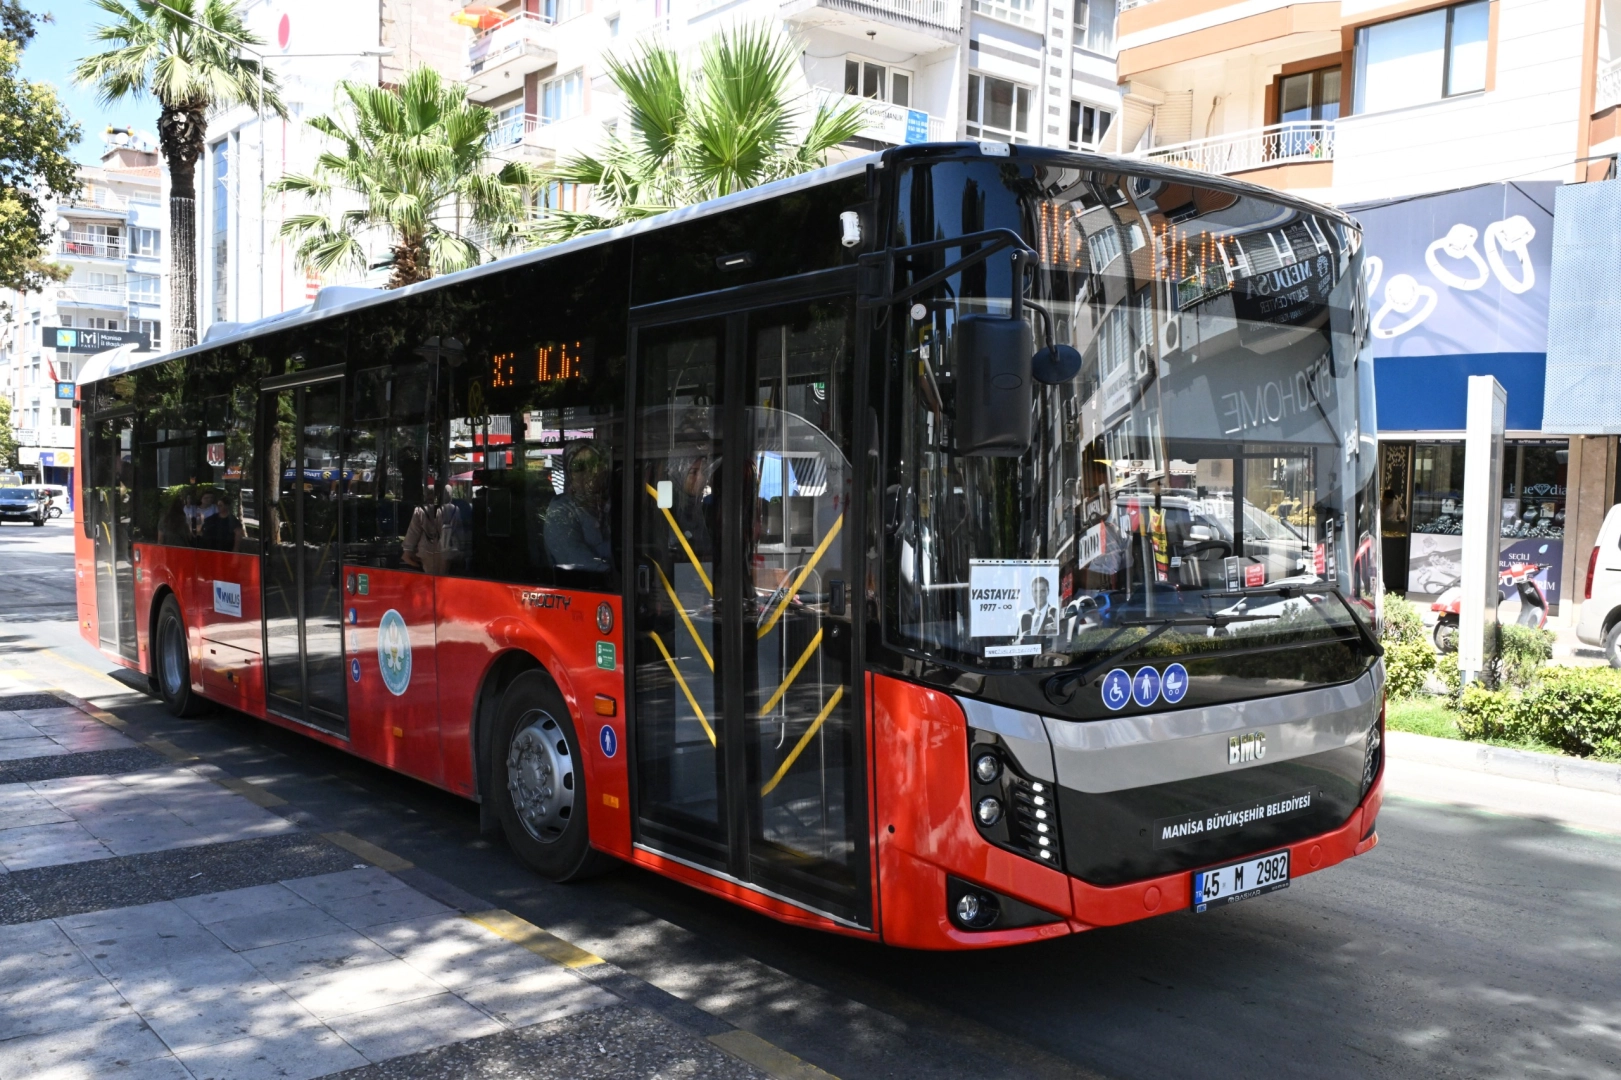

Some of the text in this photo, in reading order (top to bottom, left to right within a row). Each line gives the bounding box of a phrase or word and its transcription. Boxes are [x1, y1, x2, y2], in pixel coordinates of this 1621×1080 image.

[971, 588, 1020, 600] YASTAYIZ!
[1228, 731, 1267, 765] BMC
[1162, 792, 1311, 840] MANİSA BÜYÜKŞEHİR BELEDİYESİ
[1203, 855, 1287, 898] 45 M 2982
